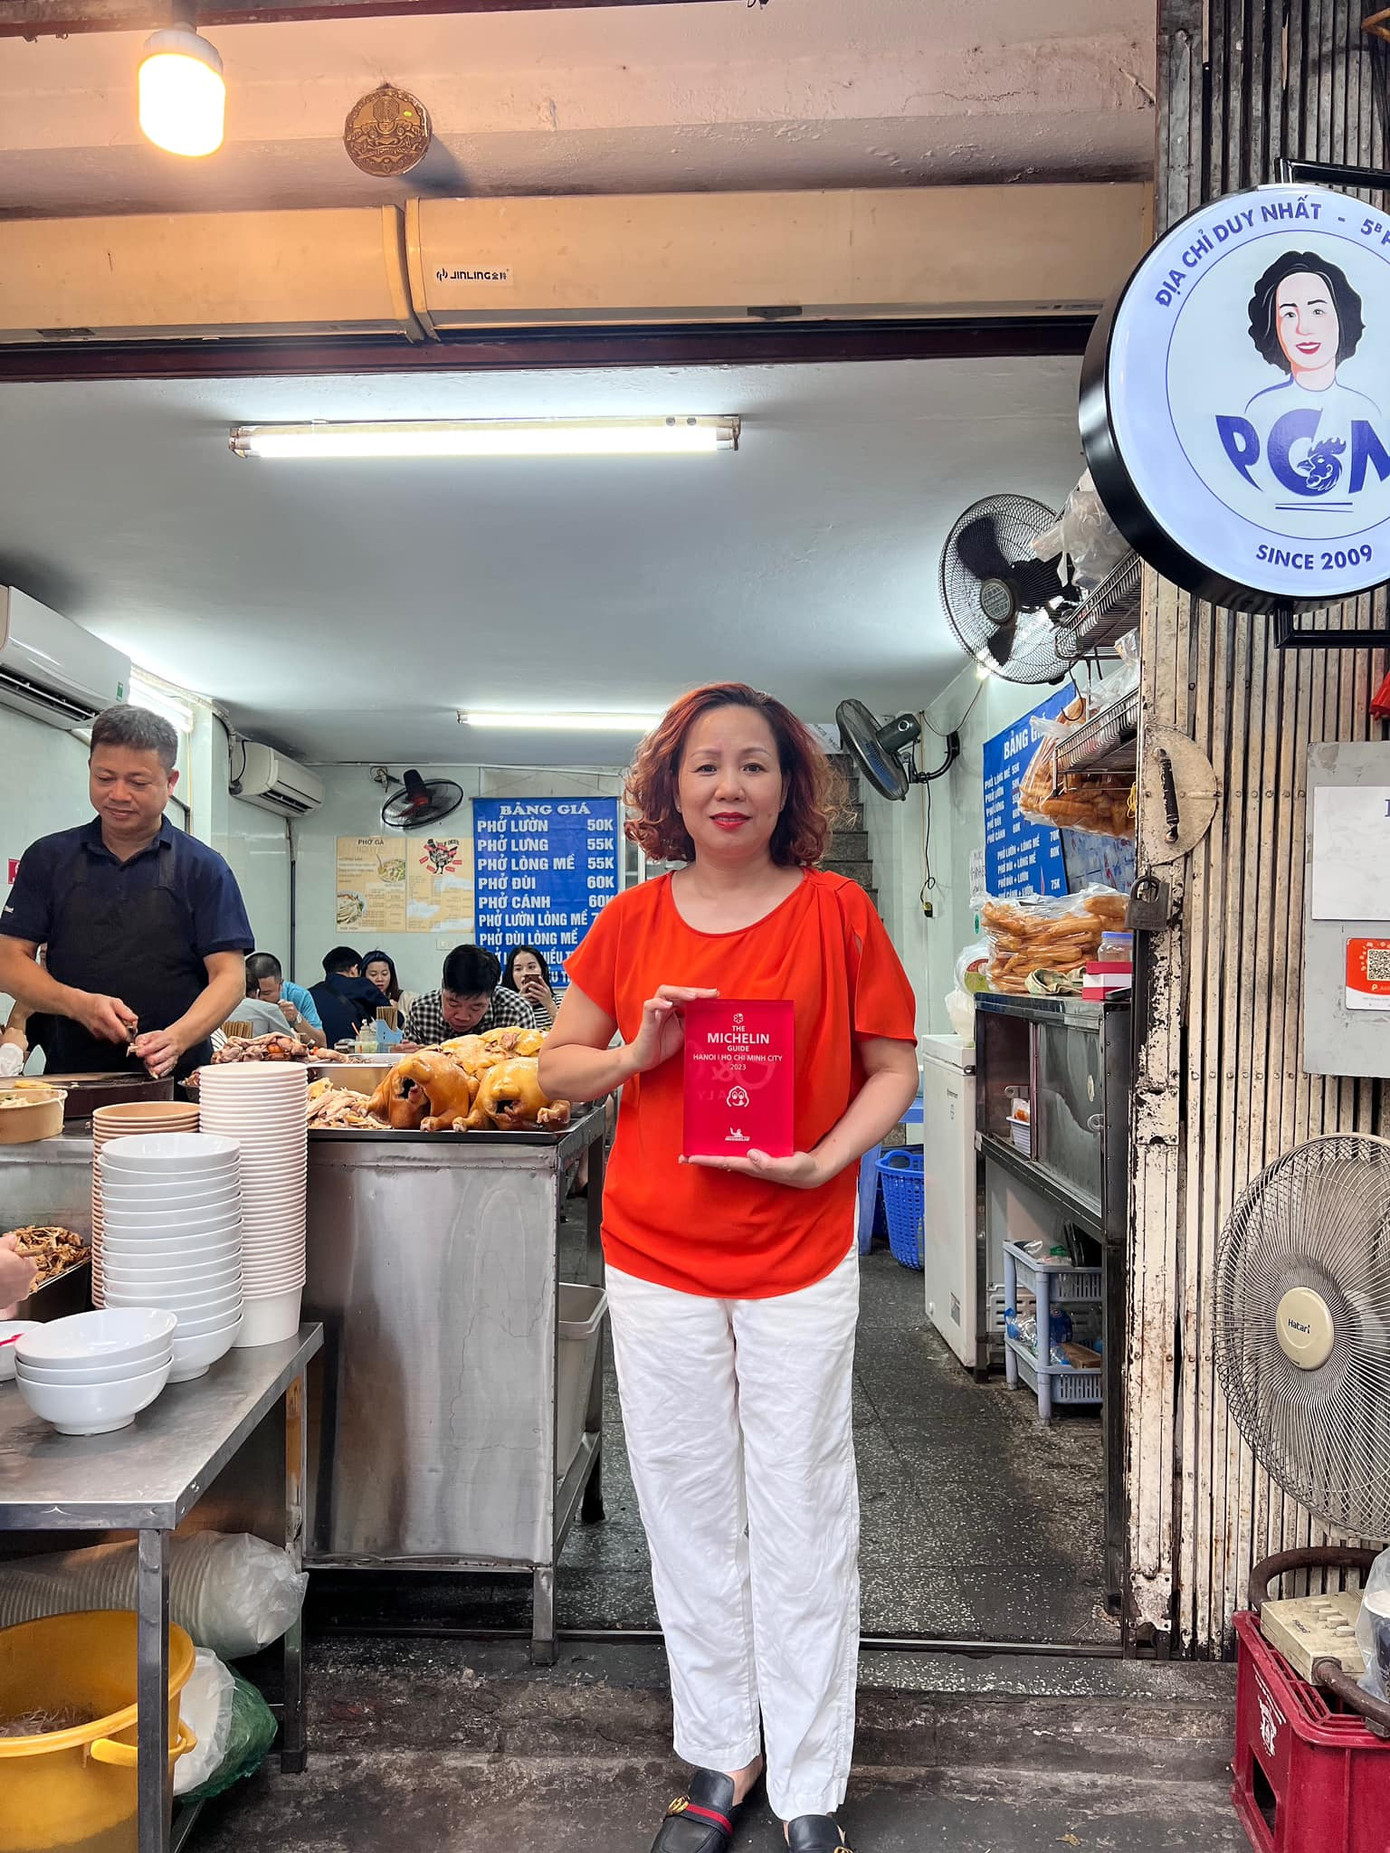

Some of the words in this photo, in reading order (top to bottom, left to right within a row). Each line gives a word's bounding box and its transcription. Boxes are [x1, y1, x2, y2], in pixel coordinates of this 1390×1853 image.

[1155, 269, 1186, 308] ĐỊA
[1182, 228, 1214, 268] CHỈ
[1213, 209, 1253, 243] DUY
[1261, 195, 1321, 222] NHẤT
[450, 271, 490, 280] JINLING
[1256, 544, 1314, 570] SINCE
[1321, 544, 1372, 570] 2009
[1004, 729, 1028, 760] BẢNG
[500, 802, 551, 815] BẢNG
[557, 802, 590, 815] GIÁ
[477, 816, 507, 832] PHỞ
[510, 817, 548, 832] LƯỜN
[587, 819, 613, 832] 50K
[478, 835, 507, 851] PHỞ
[511, 838, 549, 851] LƯNG
[587, 838, 614, 850] 55K
[478, 854, 508, 870] PHỞ
[511, 856, 549, 870] LÒNG
[587, 857, 614, 869] 55K
[478, 872, 508, 890] PHỞ
[512, 875, 536, 890] ĐÙI
[587, 876, 615, 888] 60K
[478, 891, 508, 909] PHỞ
[512, 894, 550, 908] CÁNH
[479, 909, 503, 927] PHỞ
[505, 911, 535, 926] LƯỜN
[538, 911, 567, 926] LÒNG
[480, 928, 503, 945] PHỞ
[505, 930, 525, 945] ĐÙI
[528, 930, 557, 945] LÒNG
[707, 1033, 770, 1045] MICHELIN
[693, 1053, 716, 1061] HANOI
[730, 1063, 747, 1071] 2023
[1287, 1318, 1311, 1334] Hatari
